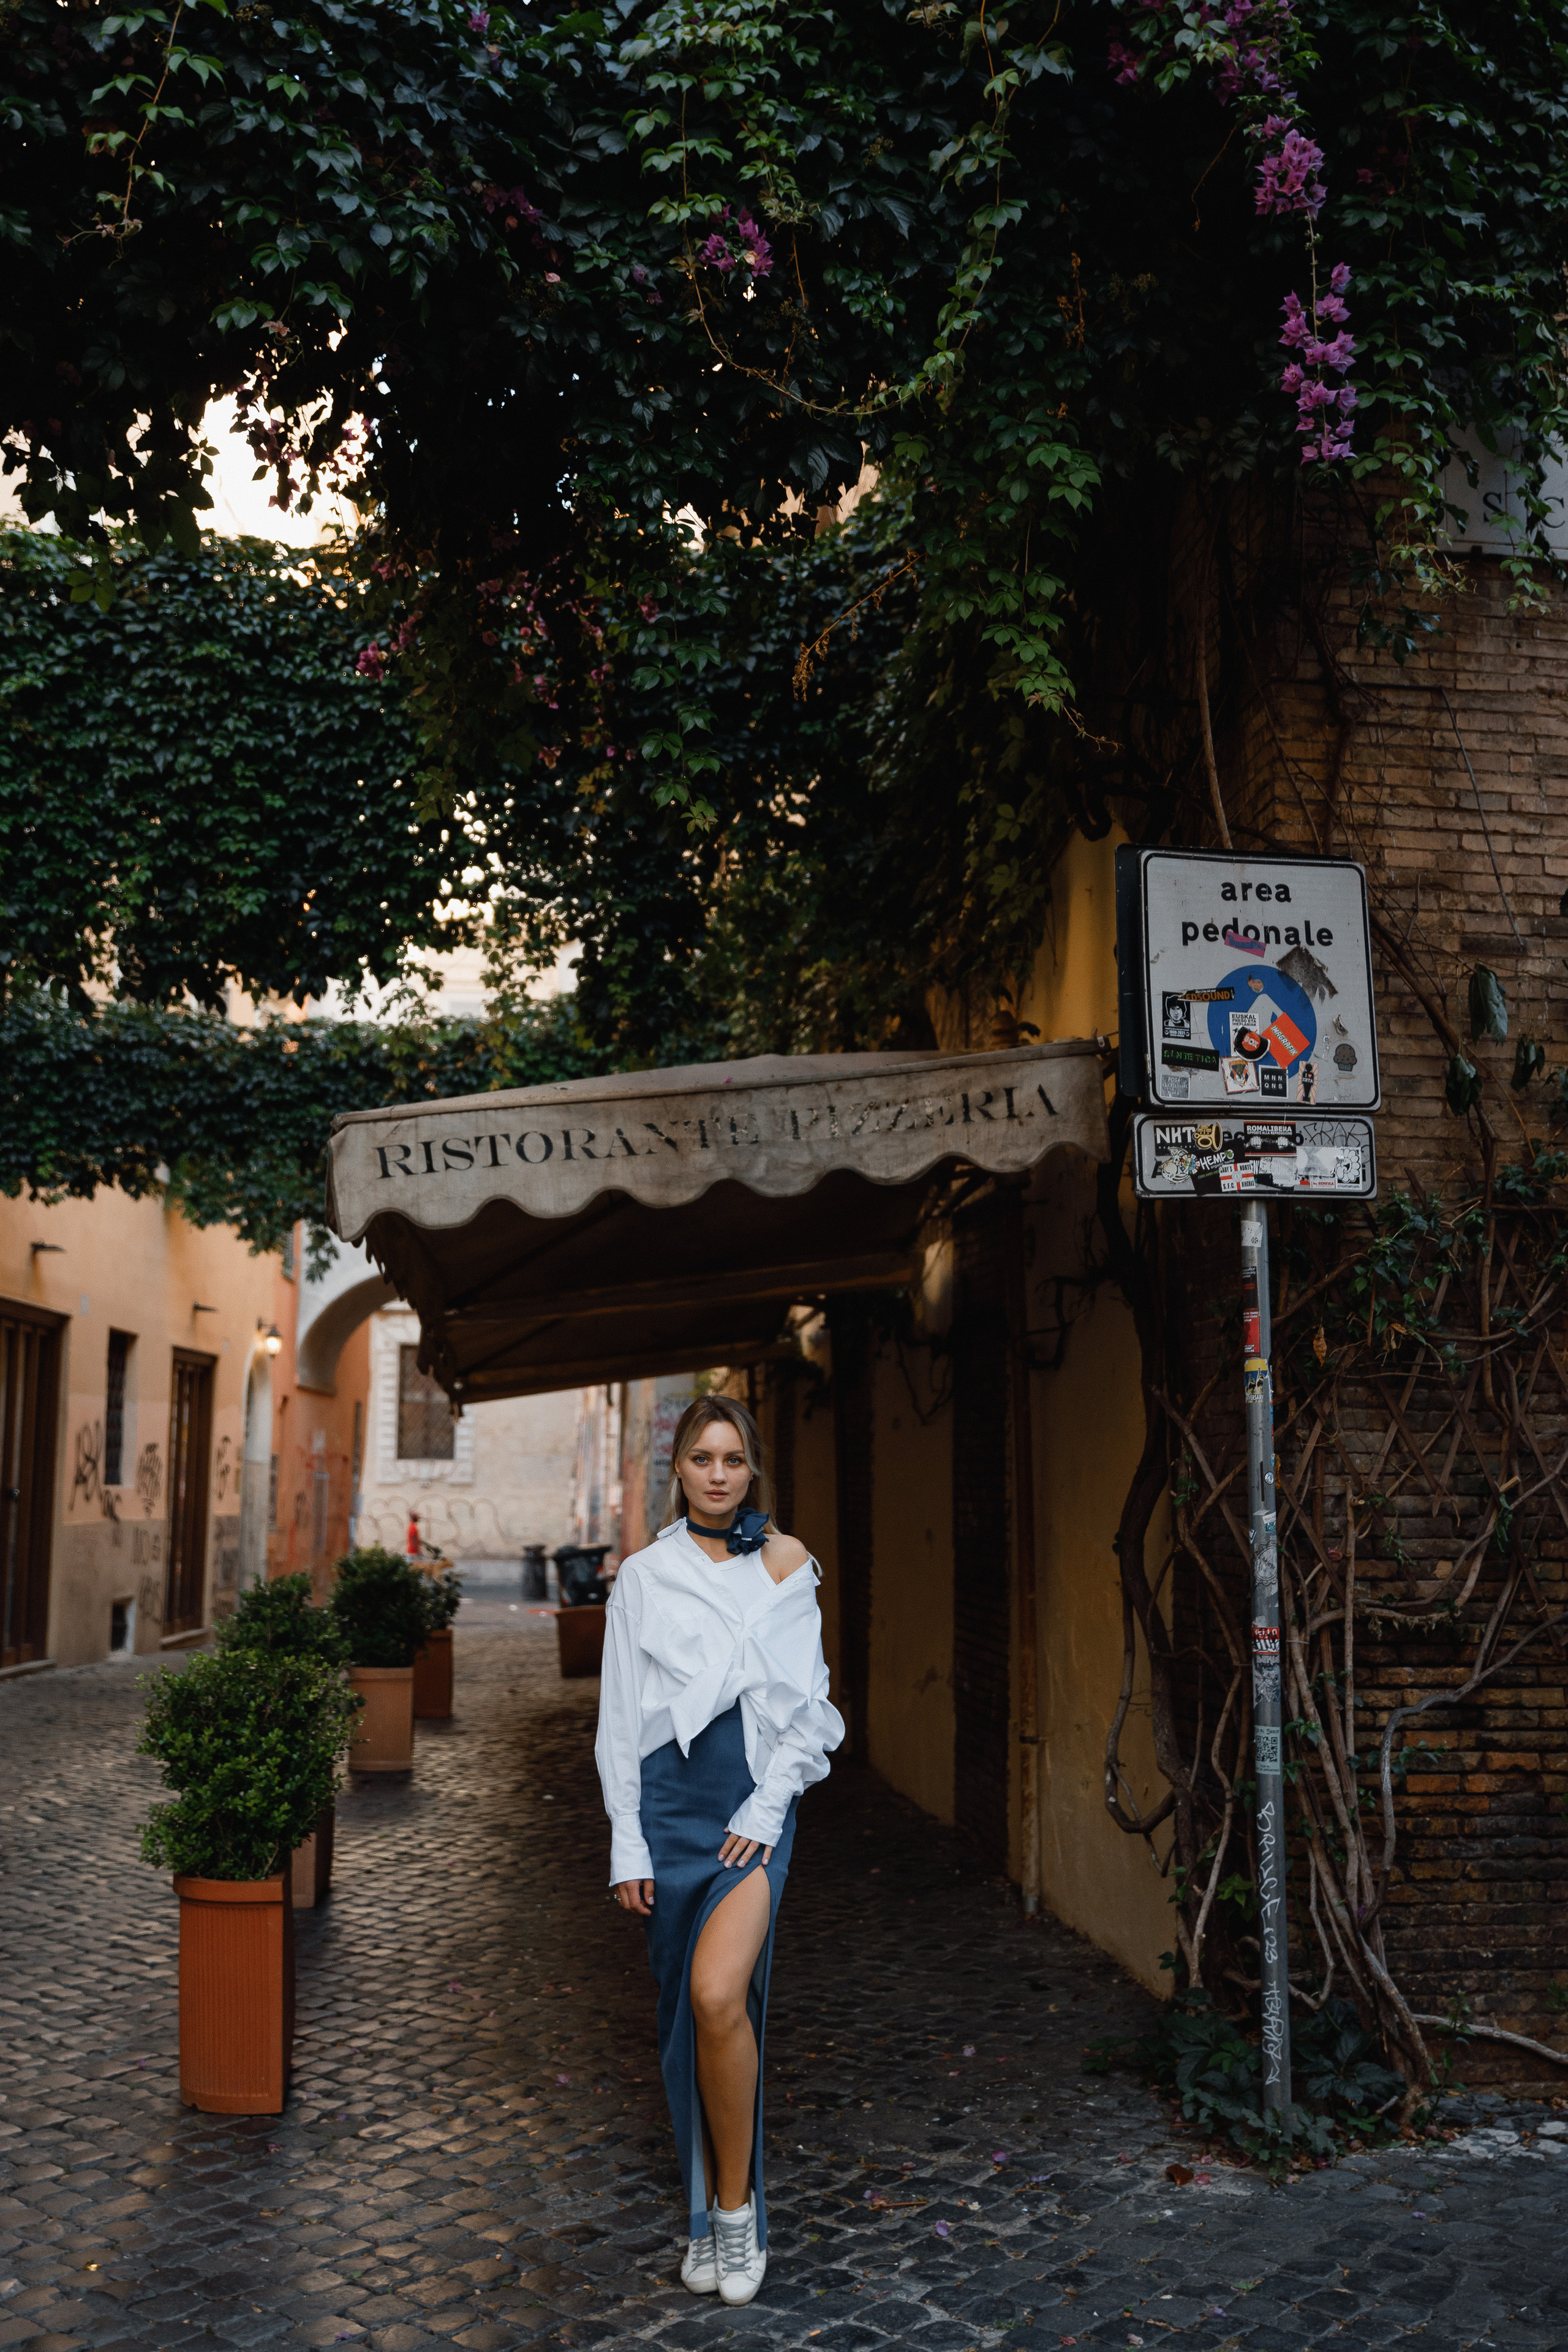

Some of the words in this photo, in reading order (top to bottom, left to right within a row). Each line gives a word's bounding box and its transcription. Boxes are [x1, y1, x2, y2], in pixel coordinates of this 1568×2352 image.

[1221, 881, 1292, 903] area
[1182, 917, 1333, 946] pedonale
[1183, 990, 1231, 1001] EDSOUND
[1164, 1050, 1217, 1064] SINTETICA
[375, 1113, 761, 1180] RISTORANTE
